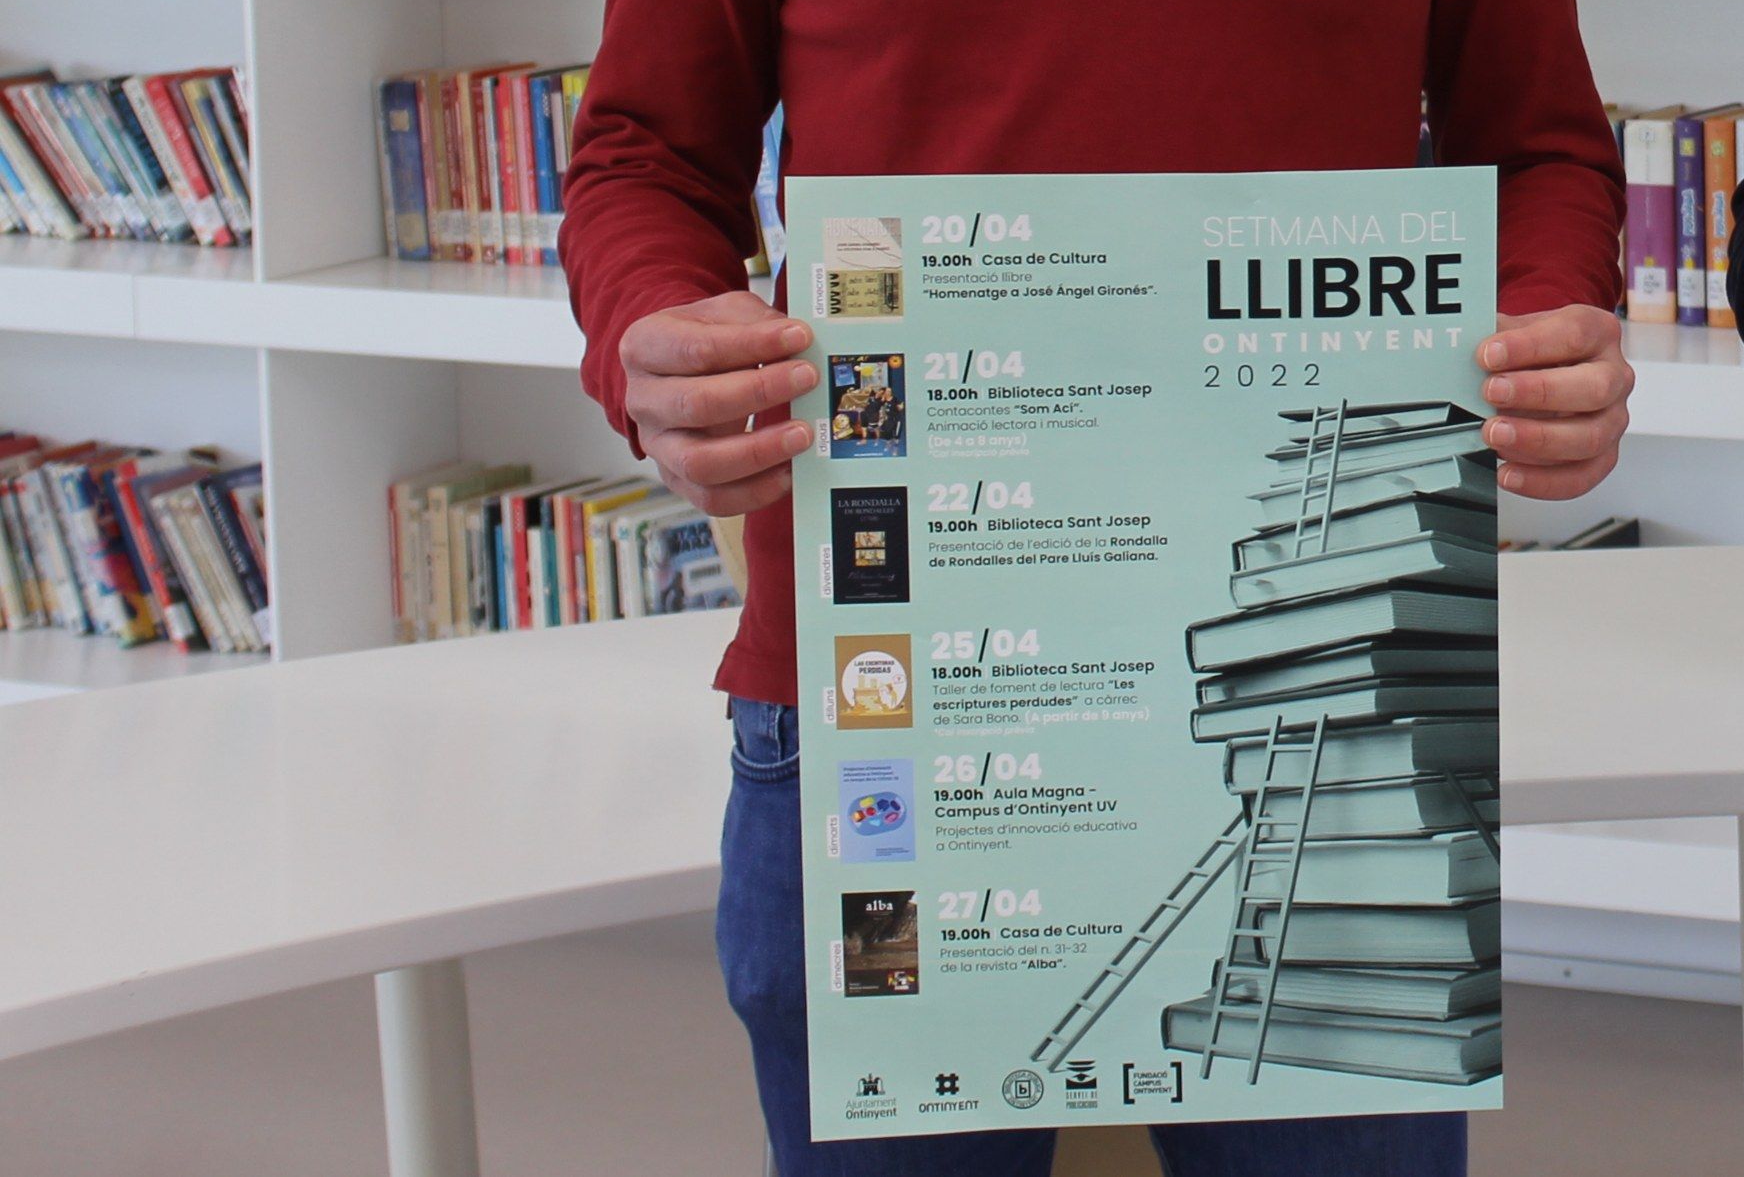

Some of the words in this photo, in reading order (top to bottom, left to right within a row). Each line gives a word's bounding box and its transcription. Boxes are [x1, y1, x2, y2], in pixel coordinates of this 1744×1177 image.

[922, 213, 1033, 247] 20/04
[1203, 215, 1385, 247] SETMANA
[1401, 211, 1466, 242] DEL
[922, 255, 972, 267] 19.00h
[982, 254, 1023, 266] Casa
[1027, 253, 1046, 265] de
[1049, 252, 1107, 265] Cultura
[922, 271, 998, 284] Presentació
[1002, 272, 1032, 283] llibre
[1207, 253, 1462, 319] LLIBRE
[1011, 289, 1019, 297] a
[1022, 285, 1053, 297] José
[1057, 284, 1094, 299] Ángel
[1203, 328, 1462, 353] ONTINYENT
[923, 349, 1025, 384] 21/04
[1204, 363, 1320, 387] 2022
[927, 389, 978, 401] 18.00h
[988, 385, 1064, 399] Biblioteca
[1068, 385, 1103, 398] Sant
[1107, 384, 1152, 400] Josep
[928, 481, 1034, 515] 22/04
[928, 521, 977, 533] 19.00h
[988, 519, 1063, 531] Biblioteca
[1067, 517, 1103, 528] Sant
[1107, 515, 1151, 530] Josep
[931, 628, 1040, 663] 25/04
[932, 667, 982, 679] 18.00h
[992, 664, 1067, 677] Biblioteca
[1071, 663, 1107, 674] Sant
[1110, 661, 1154, 676] Josep
[933, 752, 1042, 786] 26/04
[934, 789, 983, 801] 19.00h
[993, 787, 1028, 799] Aula
[1032, 786, 1085, 800] Magna
[935, 806, 1000, 820] Campus
[1096, 800, 1117, 811] UV
[830, 817, 839, 855] dimarts
[936, 824, 993, 839] Projectes
[1074, 820, 1137, 831] educativa
[936, 840, 945, 851] a
[948, 838, 1012, 853] Ontinyent.
[866, 900, 893, 911] alba
[938, 889, 1041, 922] 27/04
[941, 928, 990, 941] 19.00h
[1000, 927, 1040, 939] Casa
[1044, 925, 1062, 937] de
[1066, 923, 1123, 936] Cultura
